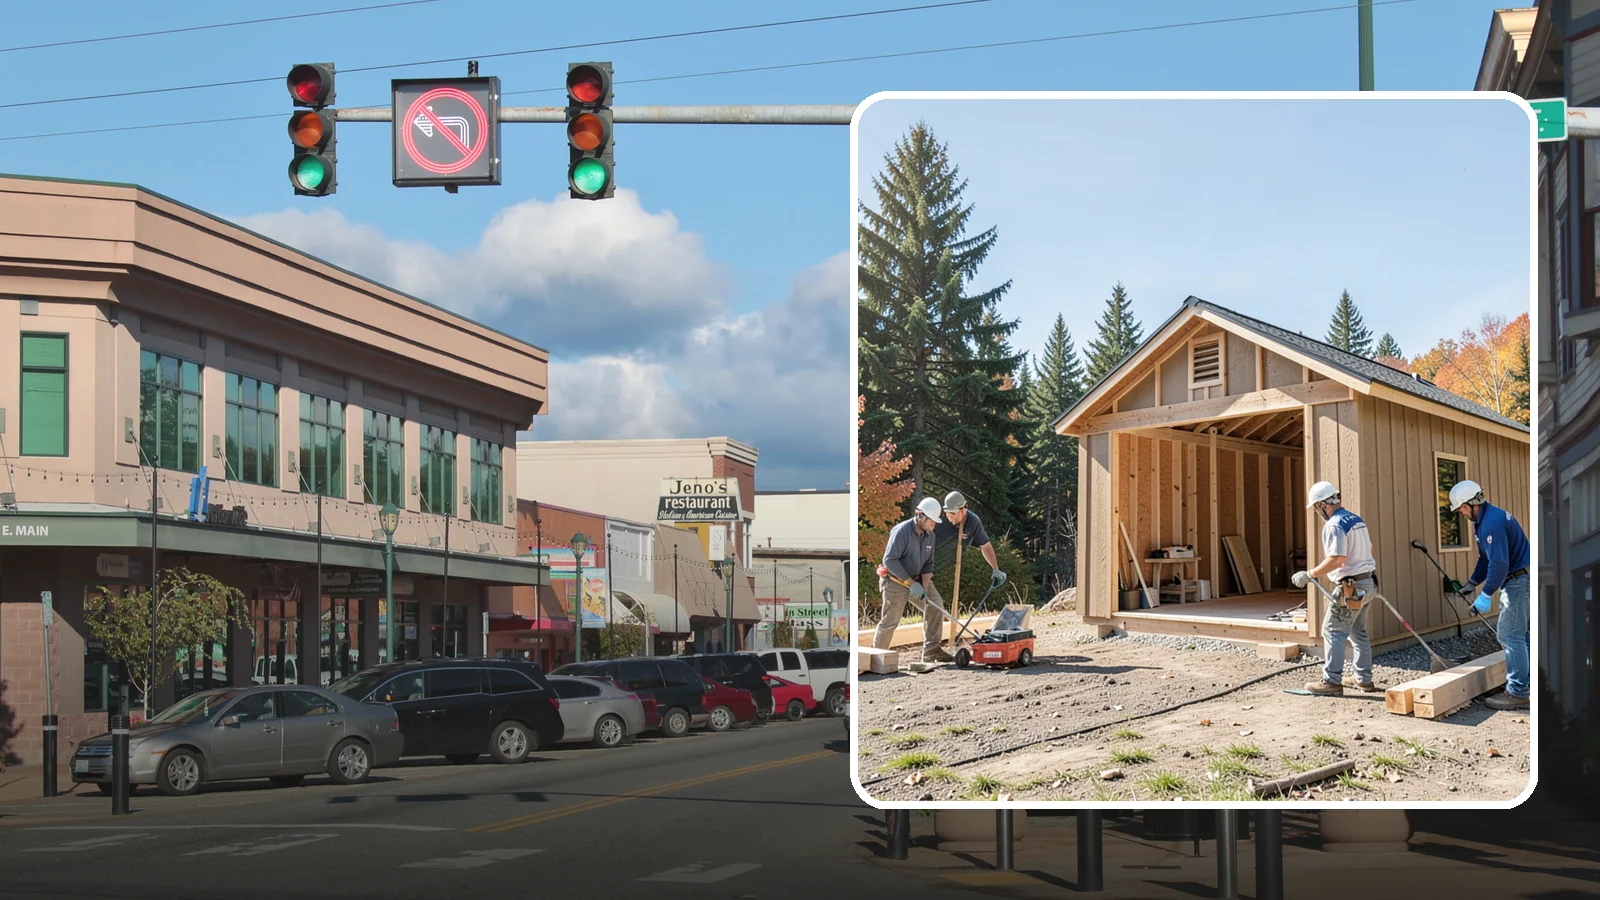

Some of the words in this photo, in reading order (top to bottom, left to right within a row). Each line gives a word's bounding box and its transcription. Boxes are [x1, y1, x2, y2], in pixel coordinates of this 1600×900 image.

[670, 480, 728, 494] Jeno's
[665, 496, 731, 508] restaurant
[658, 509, 681, 520] Italian
[686, 509, 714, 519] American
[715, 509, 738, 519] Cuisine
[2, 525, 13, 536] E.
[15, 526, 49, 536] MAIN
[797, 607, 829, 617] Street
[791, 619, 824, 627] lass
